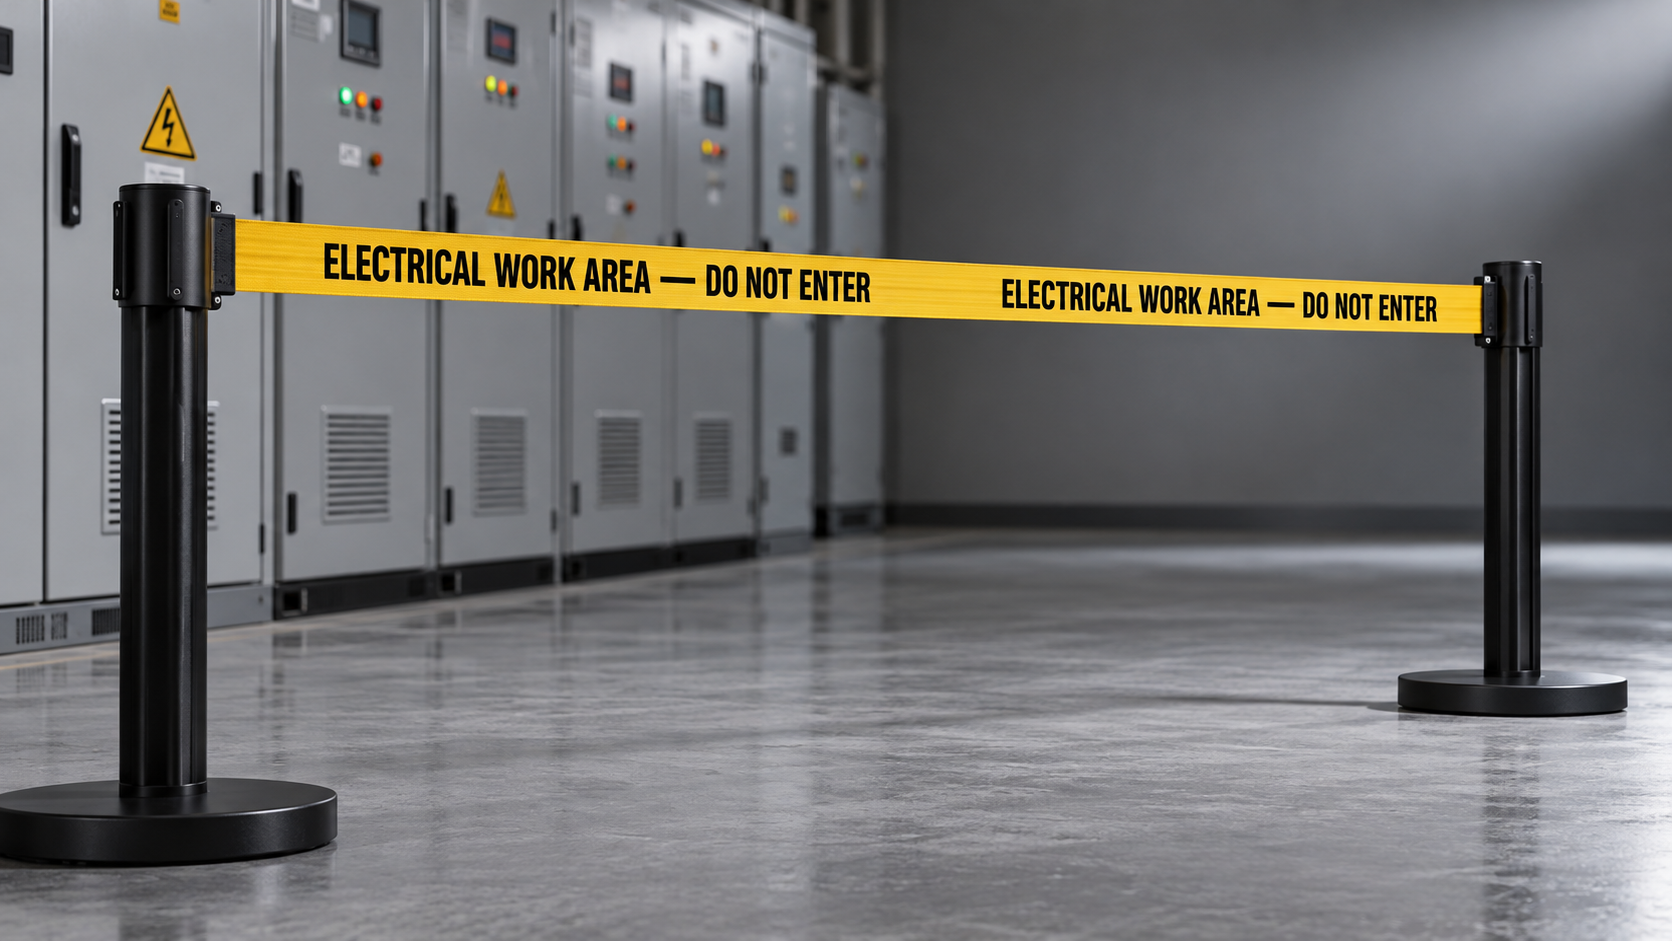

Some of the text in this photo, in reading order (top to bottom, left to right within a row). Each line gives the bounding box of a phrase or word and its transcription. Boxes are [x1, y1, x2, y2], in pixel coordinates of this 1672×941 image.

[324, 243, 485, 286] ELECTRICAL
[494, 253, 575, 290] WORK
[583, 258, 651, 293] AREA
[706, 265, 738, 297] DO
[747, 267, 792, 299] NOT
[800, 269, 870, 302] ENTER
[1002, 279, 1132, 312] ELECTRICAL
[1139, 285, 1202, 314] WORK
[1208, 288, 1260, 316] AREA
[1303, 292, 1328, 319] DO
[1336, 293, 1373, 320] NOT
[1380, 295, 1437, 322] ENTER
